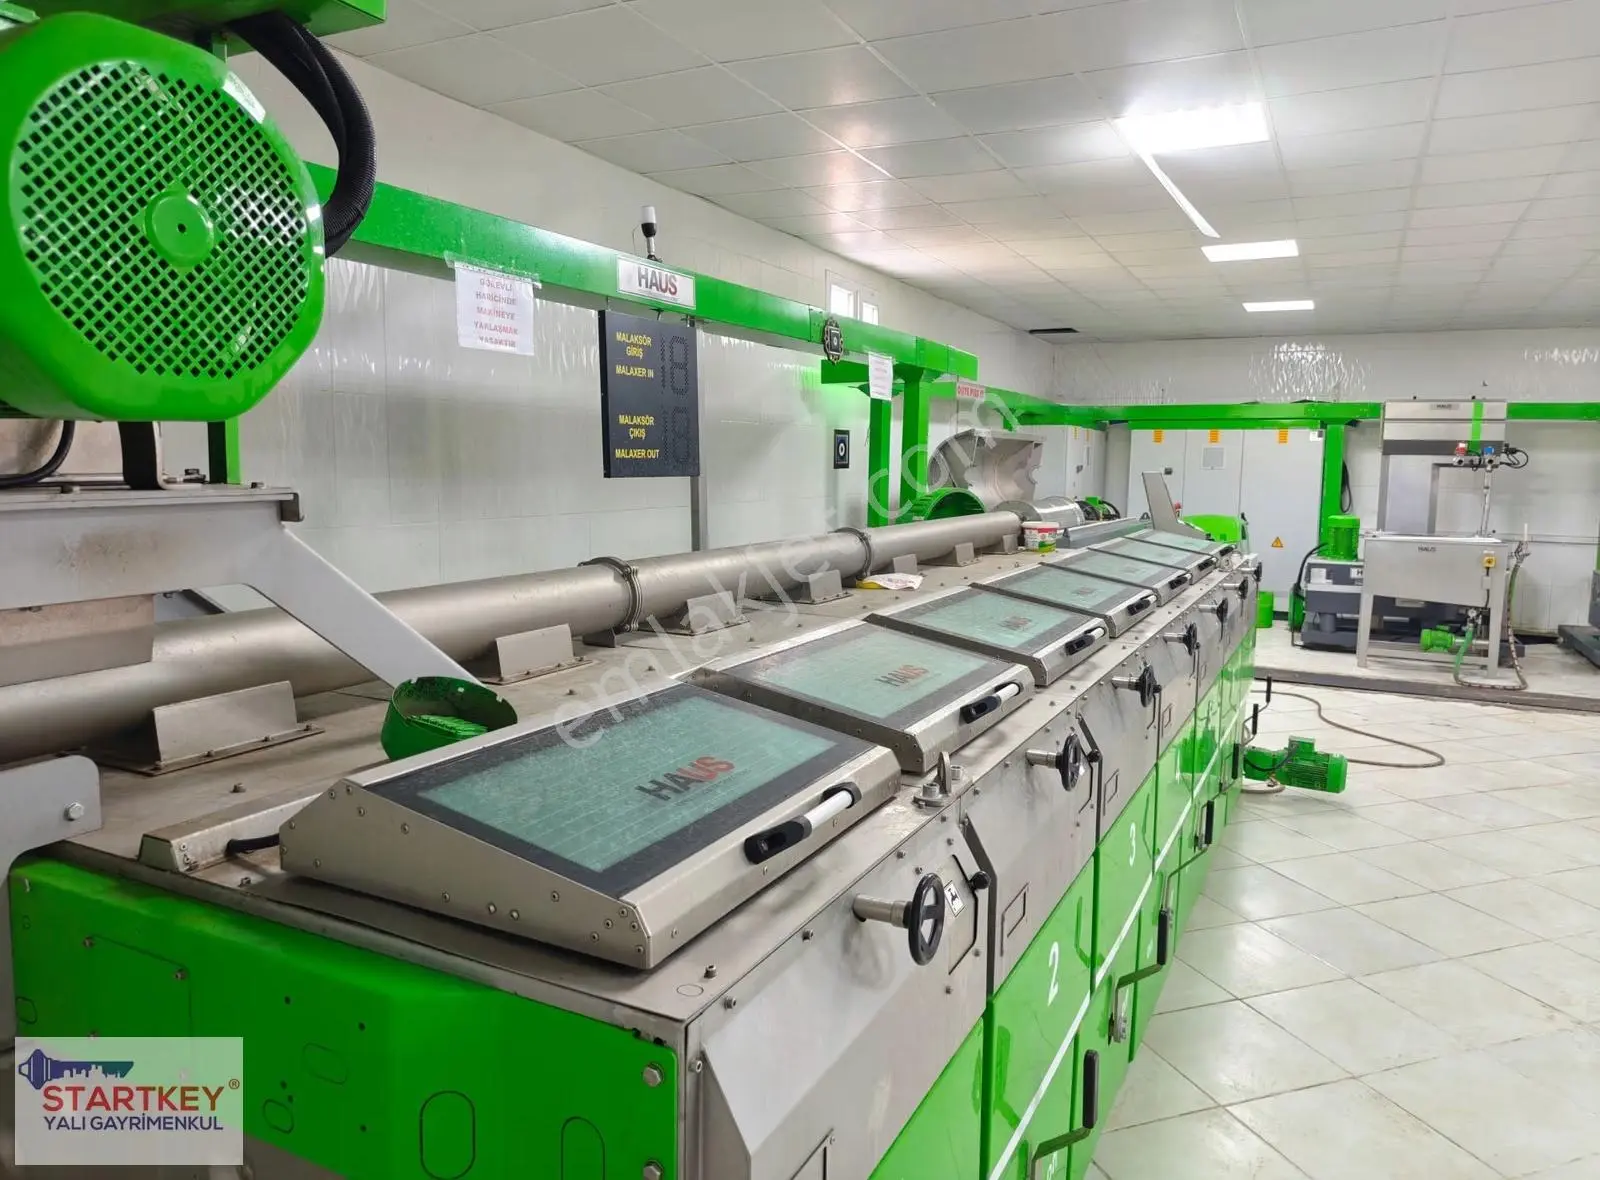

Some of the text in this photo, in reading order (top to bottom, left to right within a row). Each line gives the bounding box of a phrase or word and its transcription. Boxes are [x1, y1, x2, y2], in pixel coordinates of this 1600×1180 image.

[637, 265, 678, 296] HAUS
[616, 331, 653, 347] MALAKSÖR
[625, 344, 644, 360] GİRİŞ
[615, 364, 655, 379] MALAXER IN
[618, 413, 655, 426] MALAKSÖR
[628, 427, 646, 441] ÇIKIŞ
[615, 448, 660, 459] MALAXER OUT
[634, 756, 736, 801] HAUS
[1129, 821, 1136, 867] 3
[1046, 941, 1060, 1007] 2
